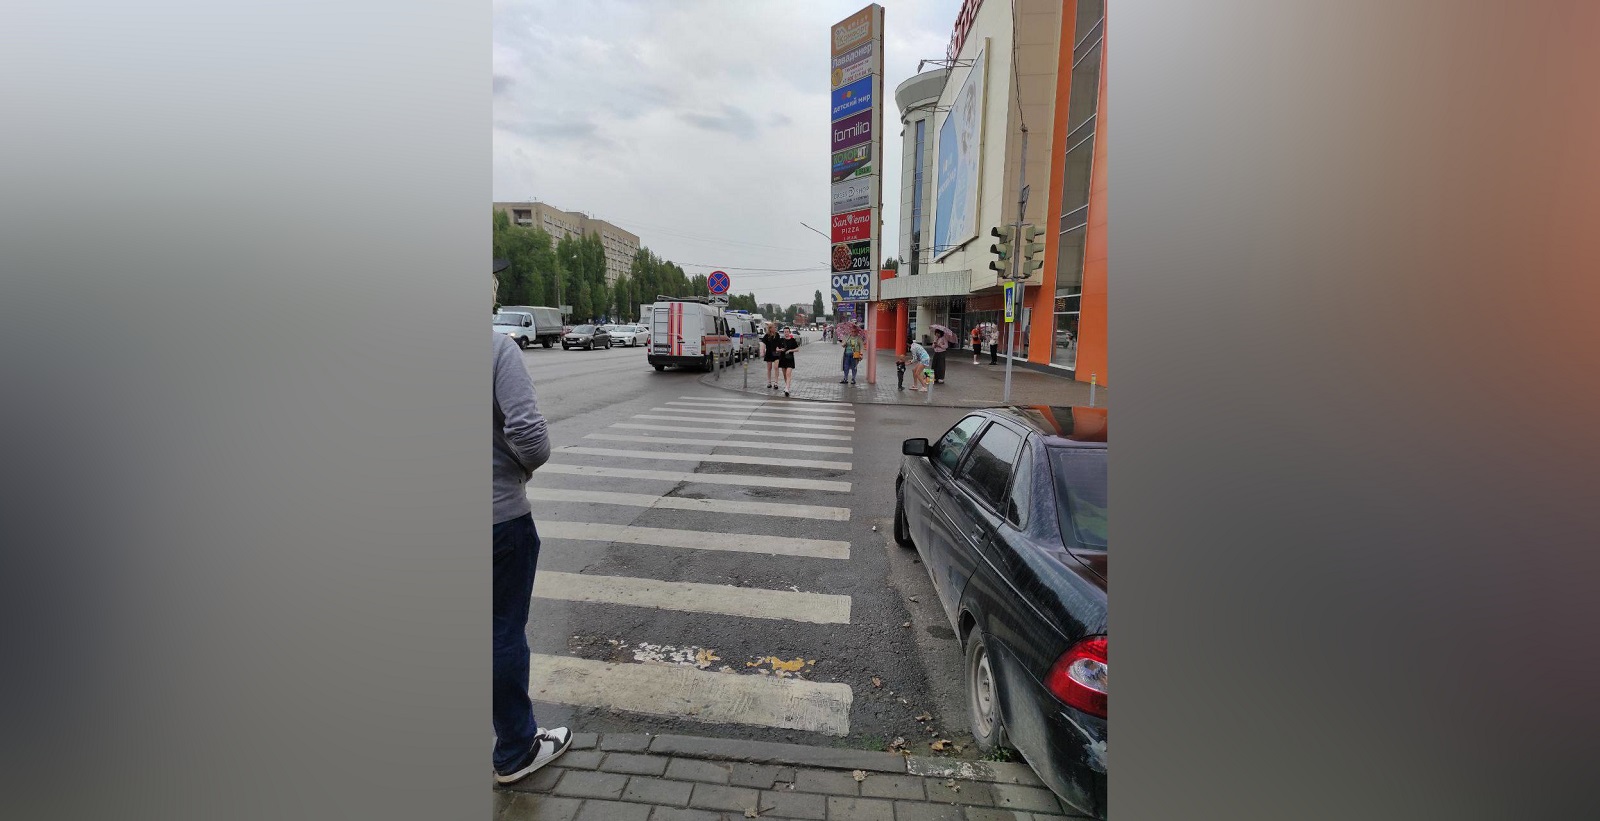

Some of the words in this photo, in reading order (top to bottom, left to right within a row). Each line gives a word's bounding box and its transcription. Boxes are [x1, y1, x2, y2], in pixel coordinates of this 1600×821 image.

[833, 97, 857, 114] детский
[858, 94, 870, 104] мир
[834, 121, 870, 143] familia
[833, 217, 847, 228] San
[841, 226, 860, 234] PIZZA
[832, 274, 870, 288] ОСАГО
[849, 289, 870, 297] КАСКО
